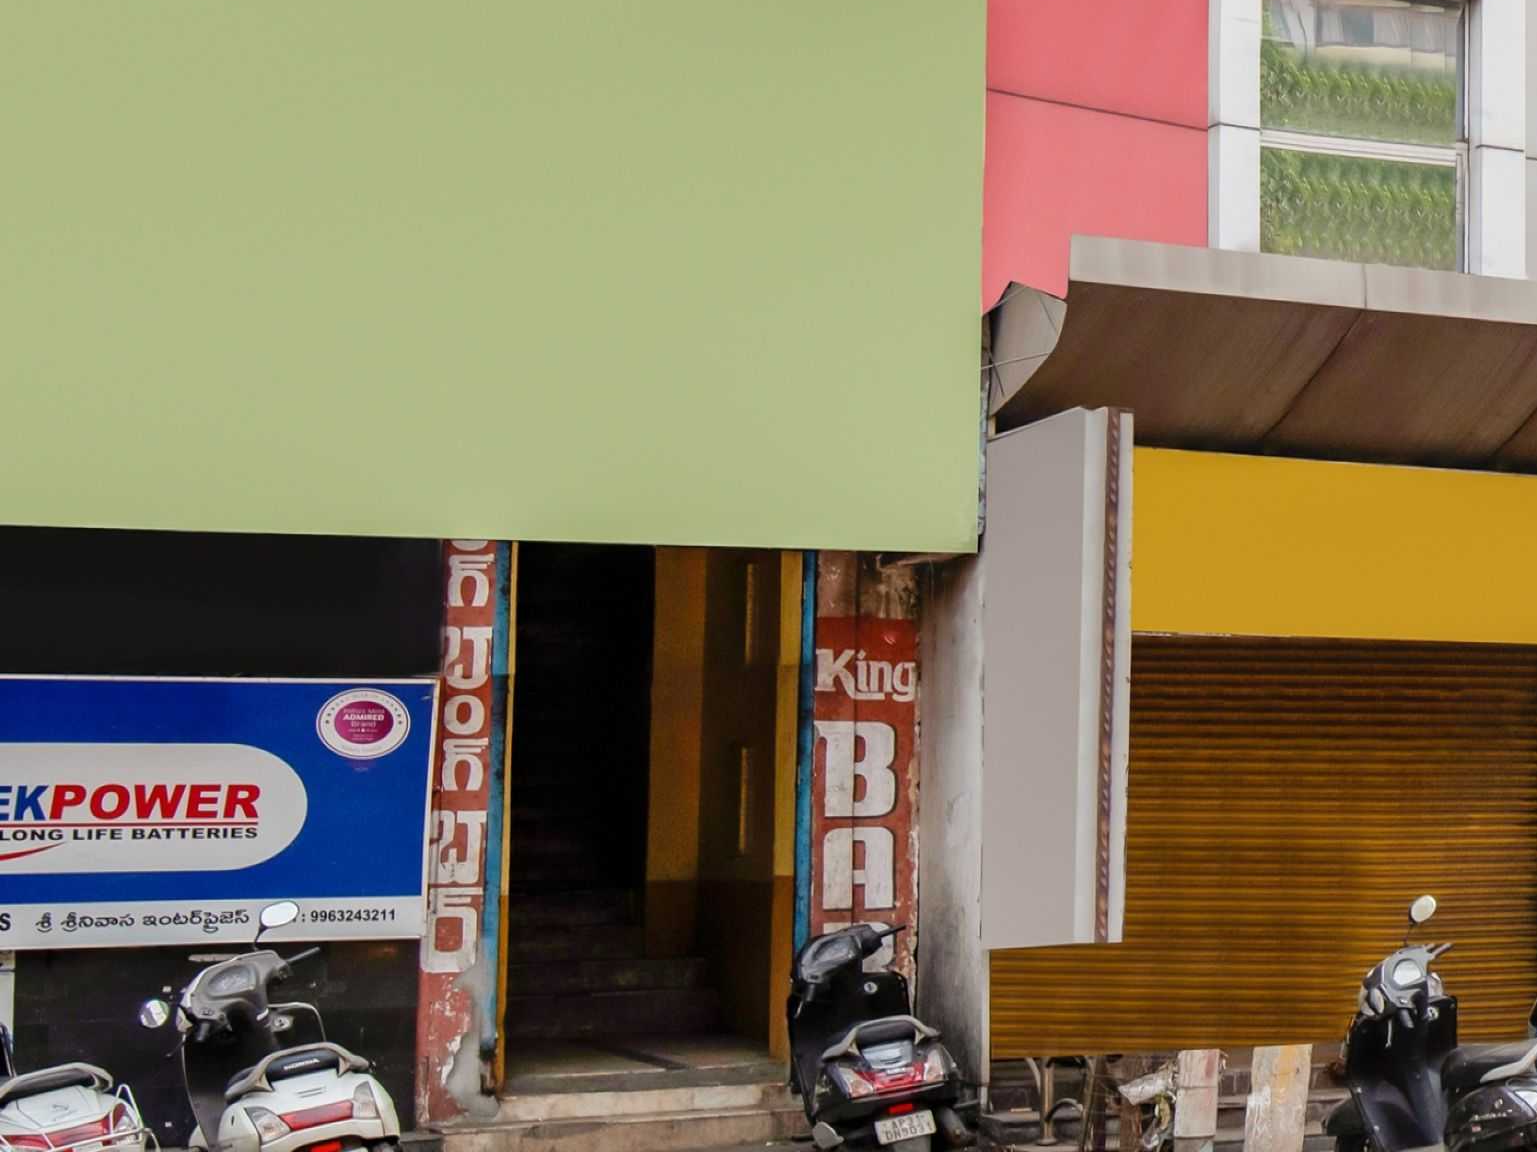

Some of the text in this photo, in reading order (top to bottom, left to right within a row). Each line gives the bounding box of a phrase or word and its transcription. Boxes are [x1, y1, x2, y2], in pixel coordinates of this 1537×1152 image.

[813, 649, 917, 702] King
[343, 713, 385, 721] ADMIRED
[73, 828, 123, 841] LIFE
[131, 826, 259, 841] BATTERIES
[310, 908, 397, 924] 9963243211
